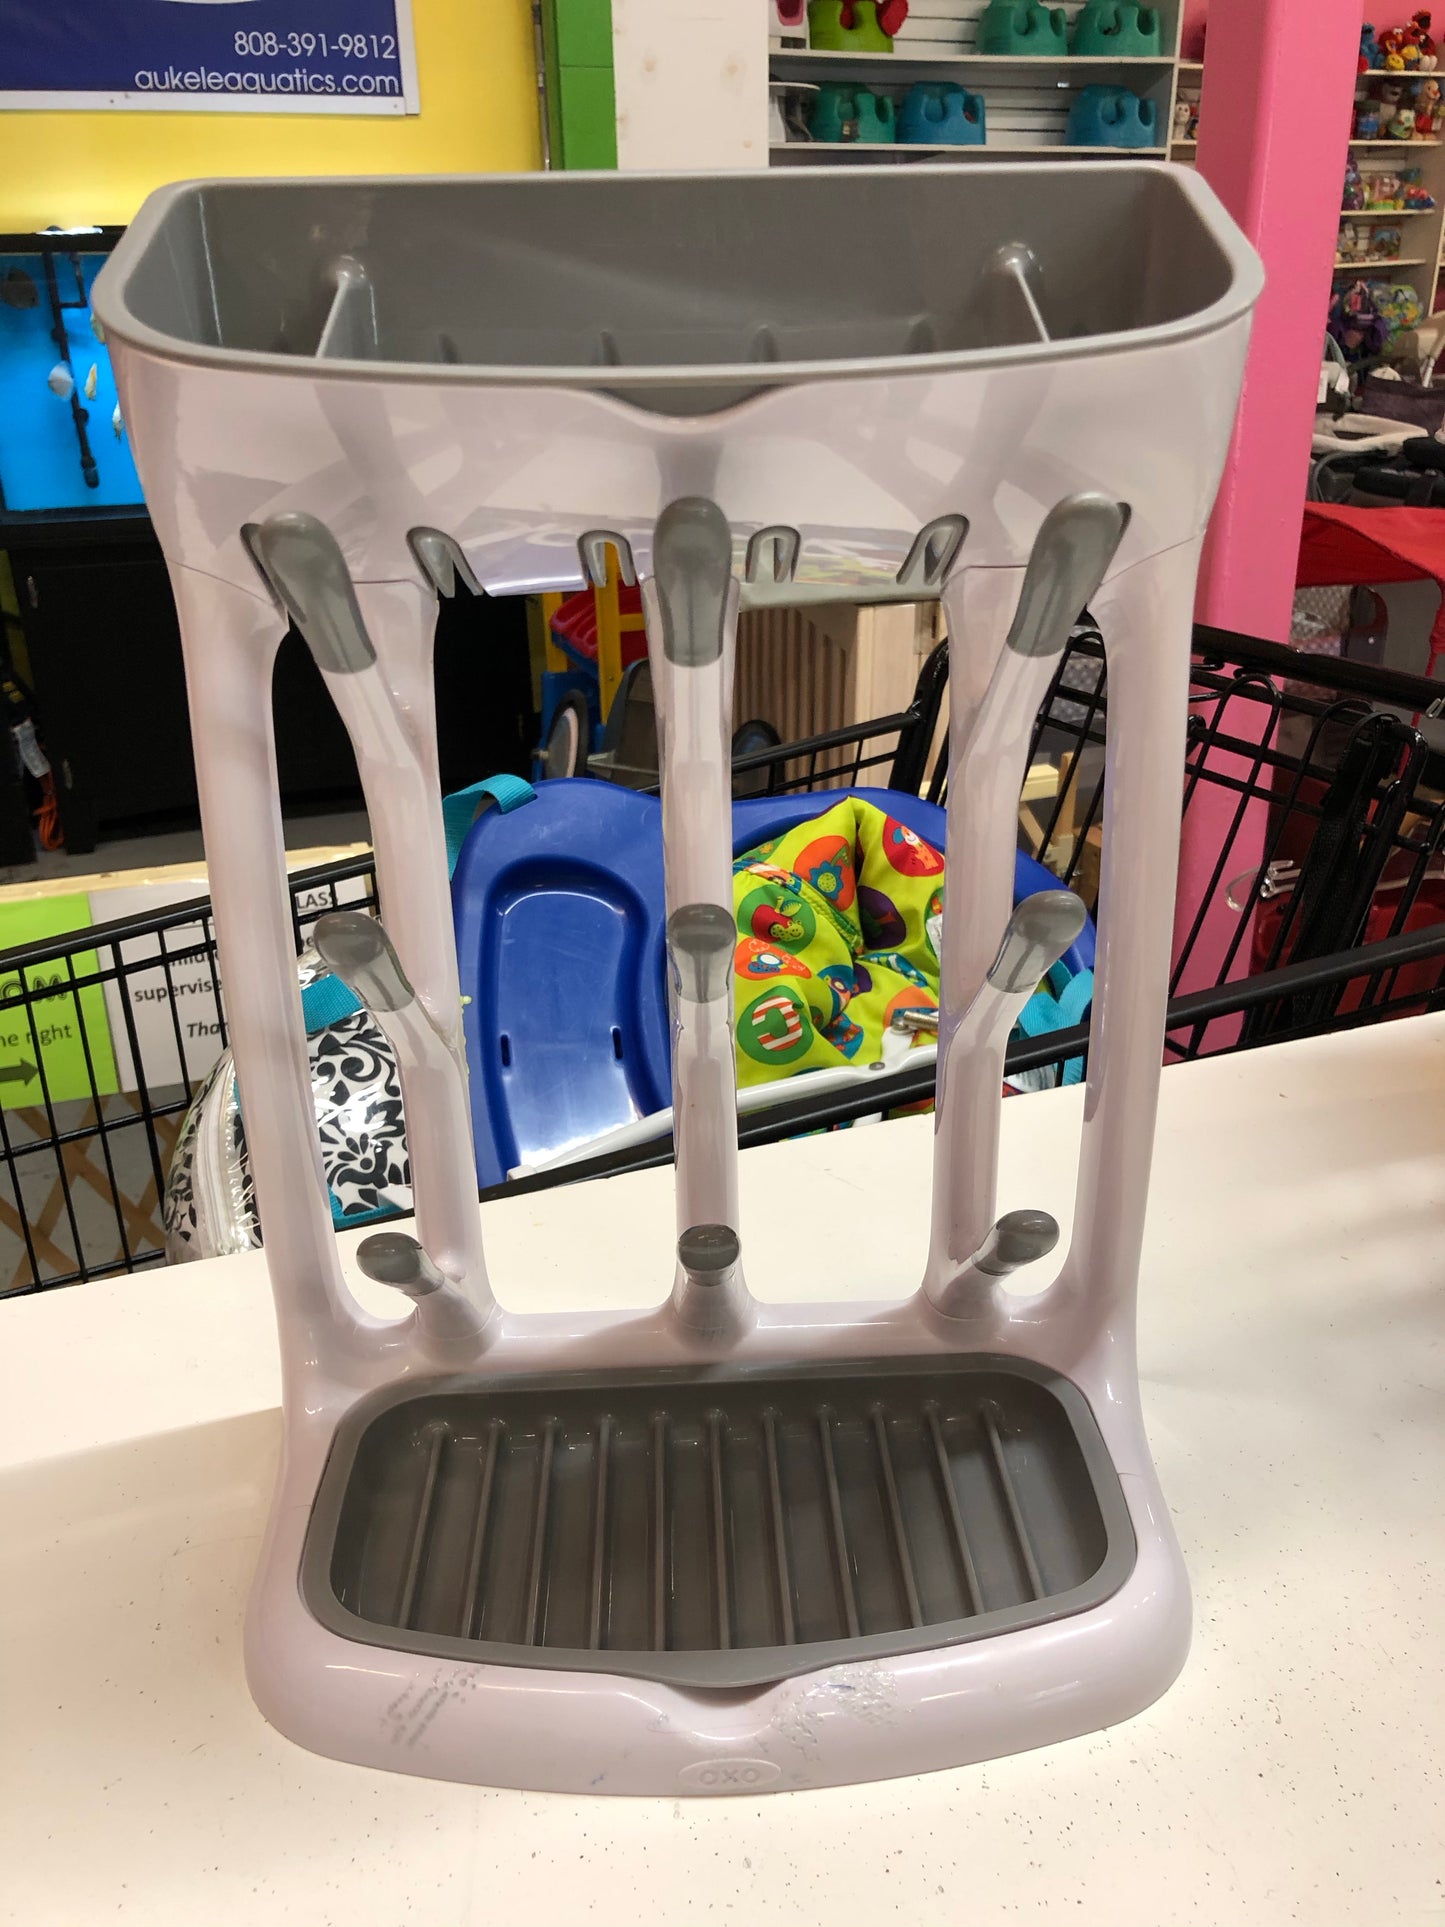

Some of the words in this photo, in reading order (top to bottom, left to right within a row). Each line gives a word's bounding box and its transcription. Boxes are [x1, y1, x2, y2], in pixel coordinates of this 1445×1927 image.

[234, 31, 396, 59] 808-391-9812
[134, 66, 400, 94] aukeleaquatics.com
[26, 1024, 73, 1046] rght
[699, 1767, 761, 1785] OXO
